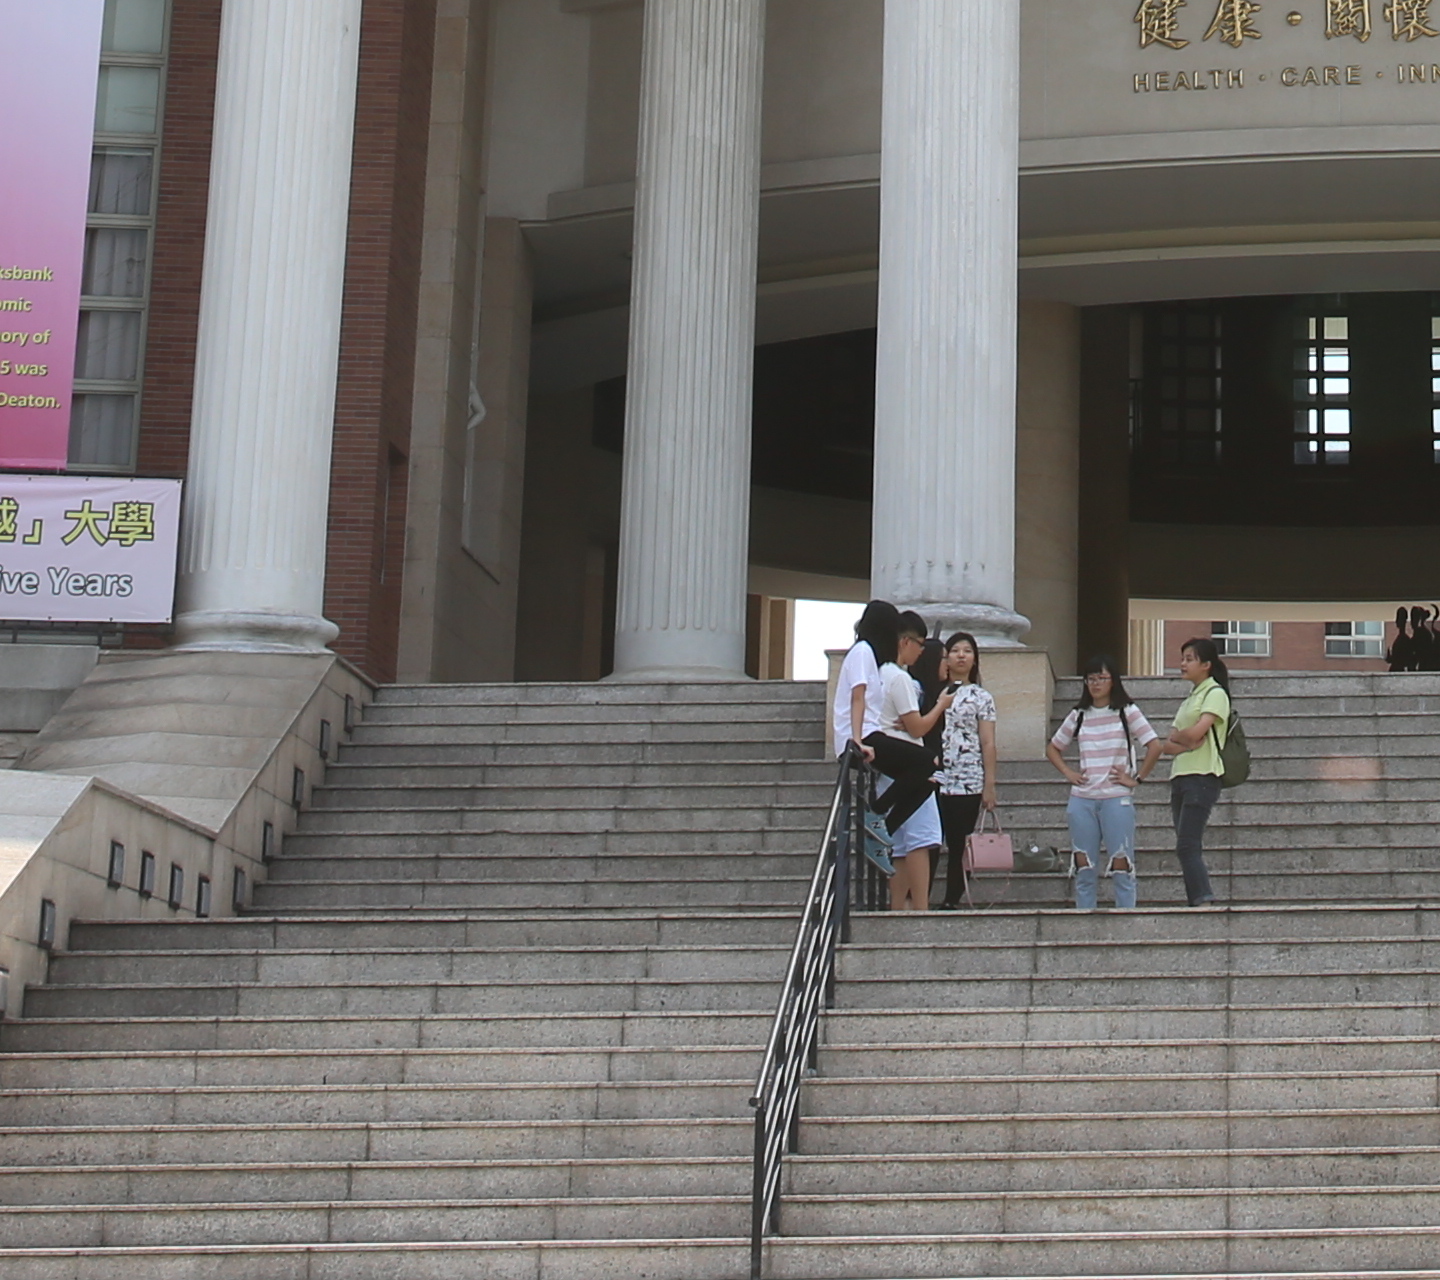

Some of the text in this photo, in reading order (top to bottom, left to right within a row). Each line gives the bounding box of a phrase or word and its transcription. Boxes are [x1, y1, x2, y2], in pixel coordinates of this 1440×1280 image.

[1133, 69, 1245, 92] HEALTH
[1280, 65, 1362, 86] CARE
[15, 364, 47, 375] was
[47, 566, 133, 598] Years
